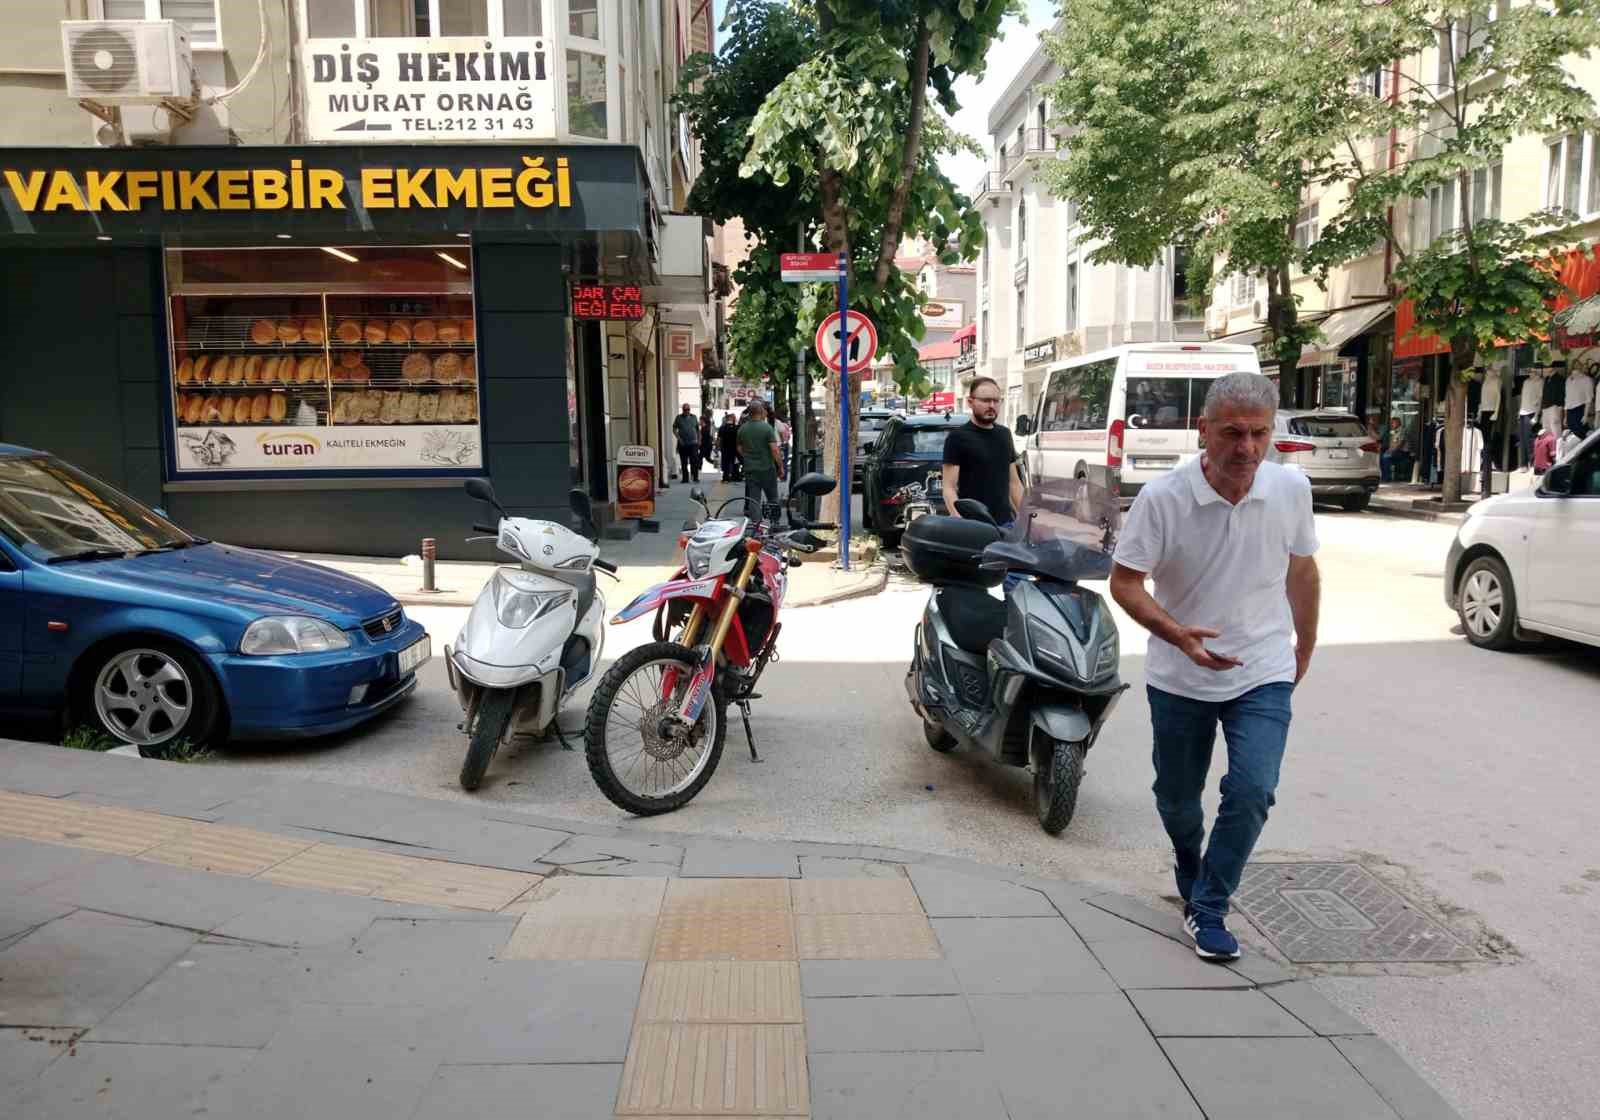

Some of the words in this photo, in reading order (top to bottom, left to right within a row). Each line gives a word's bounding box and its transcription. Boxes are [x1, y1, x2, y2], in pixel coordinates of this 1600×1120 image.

[313, 43, 380, 89] DİŞ
[397, 41, 547, 82] HEKİMİ
[328, 93, 426, 112] MURAT
[437, 86, 533, 112] ORNAĞ
[402, 117, 477, 131] TEL:212
[485, 117, 504, 130] 31
[512, 116, 534, 130] 43
[3, 159, 346, 212] VAKFIKEBİR
[361, 156, 571, 208] EKMEĞİ
[672, 335, 687, 353] E
[263, 443, 314, 456] turan
